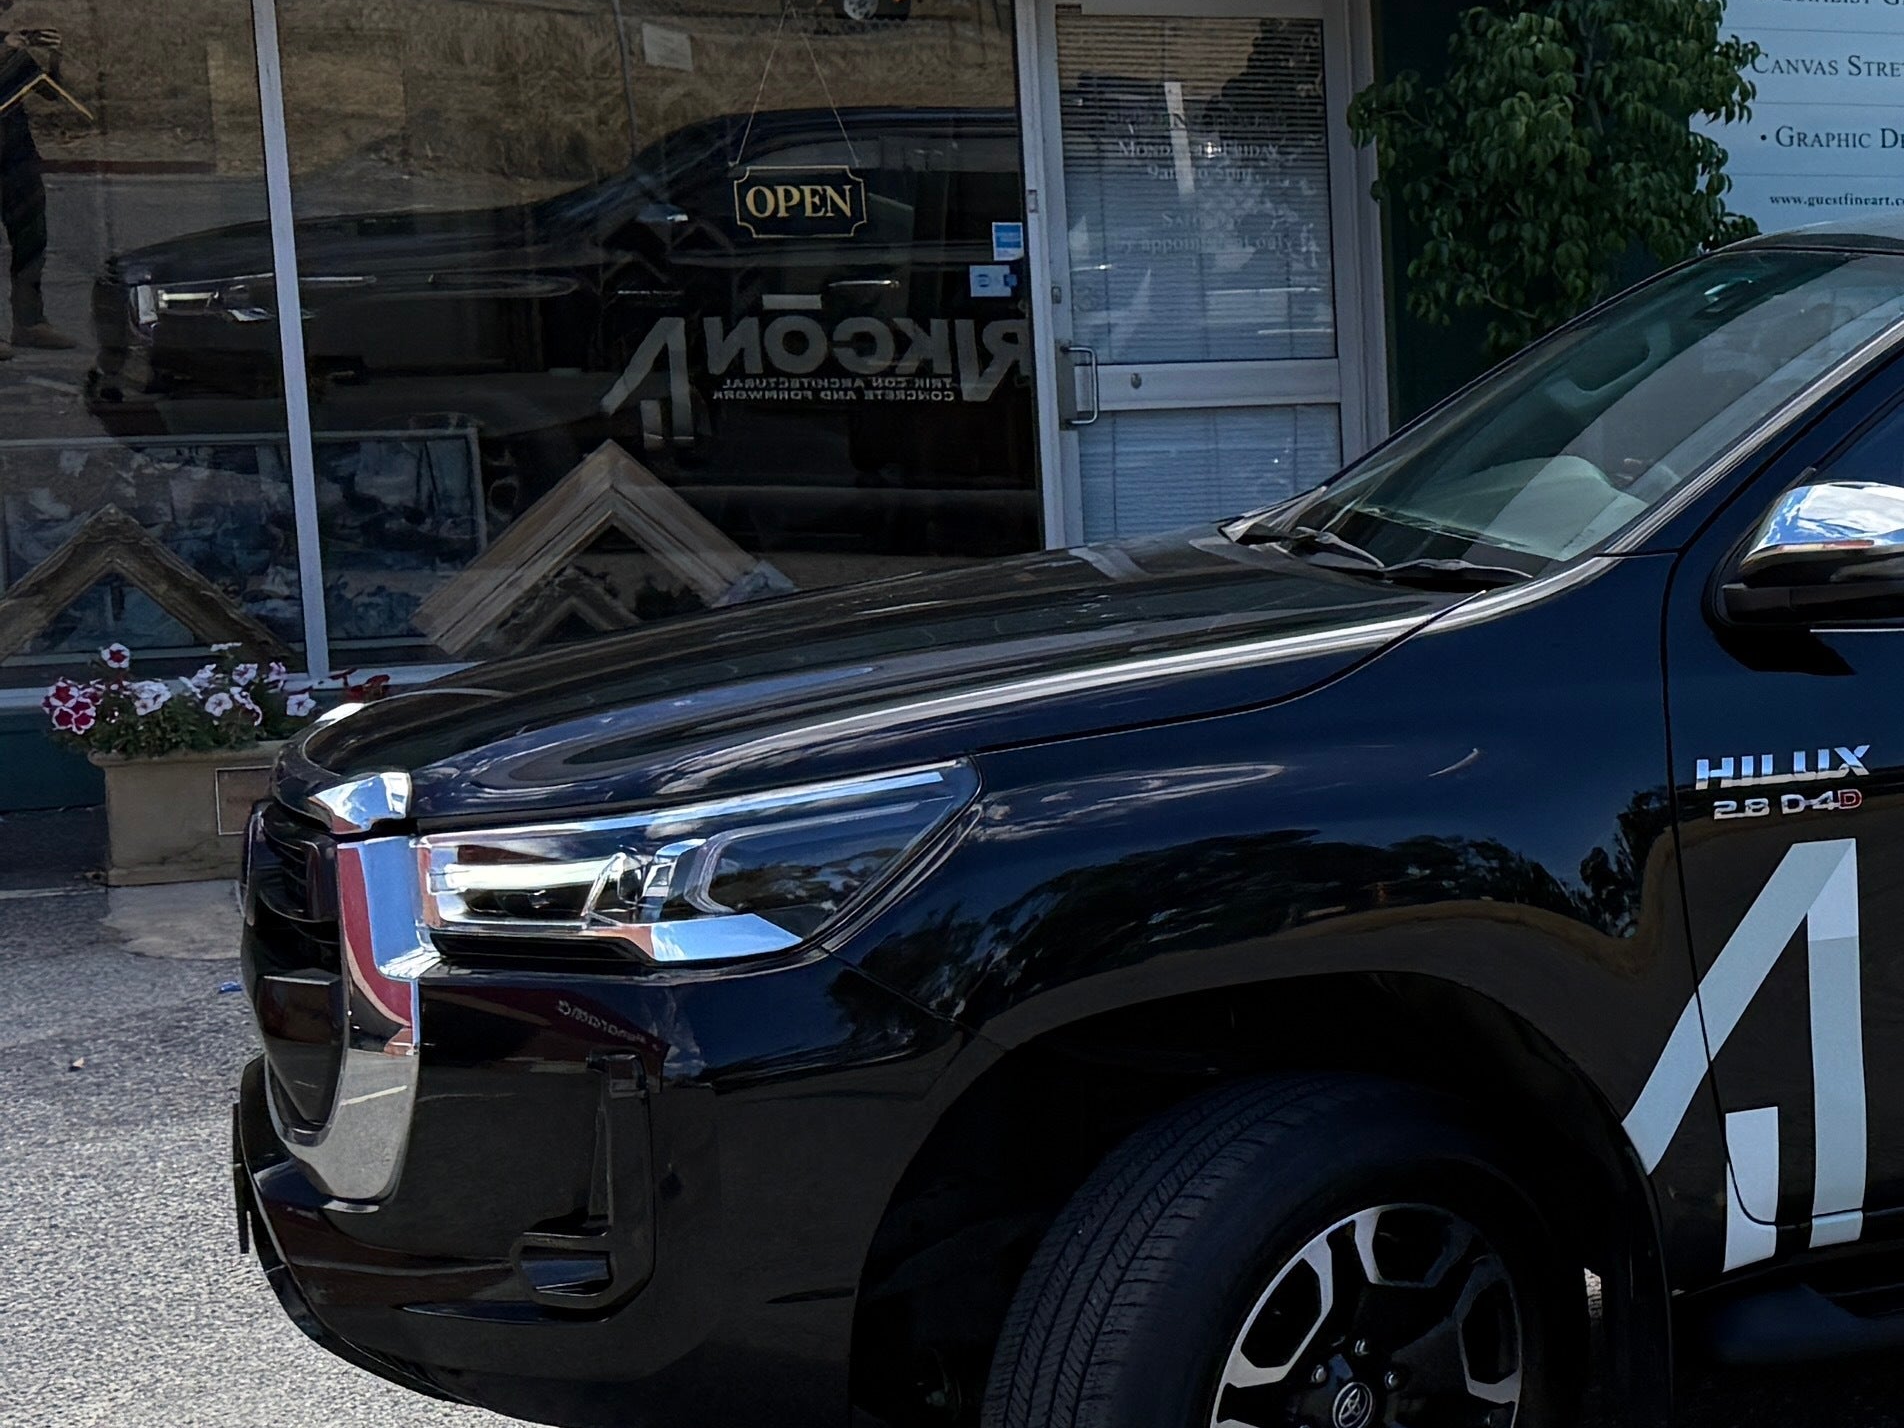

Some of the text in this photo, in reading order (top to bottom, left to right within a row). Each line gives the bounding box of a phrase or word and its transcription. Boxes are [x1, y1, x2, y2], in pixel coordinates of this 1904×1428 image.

[745, 184, 852, 220] OPEN
[1695, 744, 1871, 790] HILUX
[1780, 788, 1863, 815] D-4D
